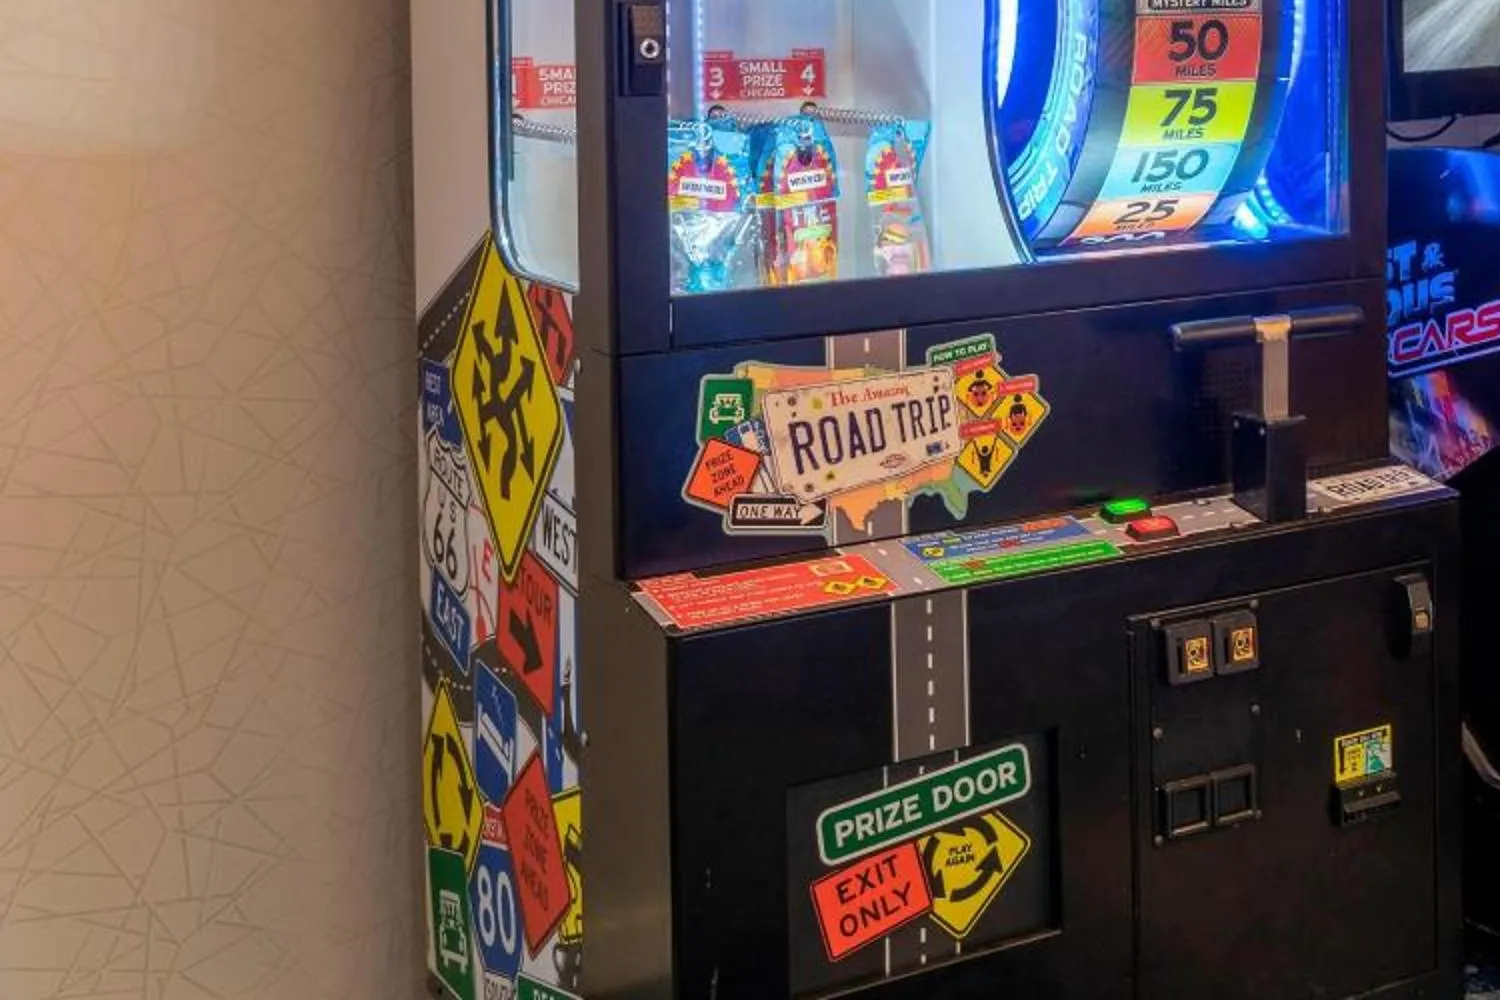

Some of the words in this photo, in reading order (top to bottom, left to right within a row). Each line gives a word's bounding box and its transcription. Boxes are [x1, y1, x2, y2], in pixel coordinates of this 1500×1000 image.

[1168, 18, 1230, 62] 50
[709, 67, 725, 87] 3
[739, 61, 787, 74] SMALL
[800, 64, 816, 84] 4
[1175, 63, 1217, 79] MILES
[543, 81, 576, 95] PRIZ
[743, 74, 784, 87] PRIZE
[740, 87, 785, 98] CHICAGO
[1160, 87, 1218, 127] 75
[1163, 127, 1205, 142] MILES
[1131, 148, 1209, 184] 150
[1140, 181, 1183, 195] MILES
[1113, 199, 1179, 225] 25
[828, 389, 858, 408] The
[788, 407, 887, 476] ROAD
[891, 393, 953, 446] TRIP
[705, 449, 735, 471] PRIZE
[710, 463, 737, 483] ZONE
[713, 475, 746, 498] AHEAD
[740, 505, 769, 519] ONE
[773, 505, 801, 519] WAY
[433, 510, 457, 581] 66
[541, 503, 578, 575] WEST
[519, 566, 555, 623] TOUR
[435, 585, 465, 650] EAST
[834, 793, 923, 849] PRIZE
[932, 761, 1018, 813] DOOR
[945, 855, 976, 867] AGAIN
[948, 843, 973, 858] PLAY
[835, 853, 898, 906] EXIT
[477, 864, 516, 956] 80
[839, 881, 912, 938] ONLY
